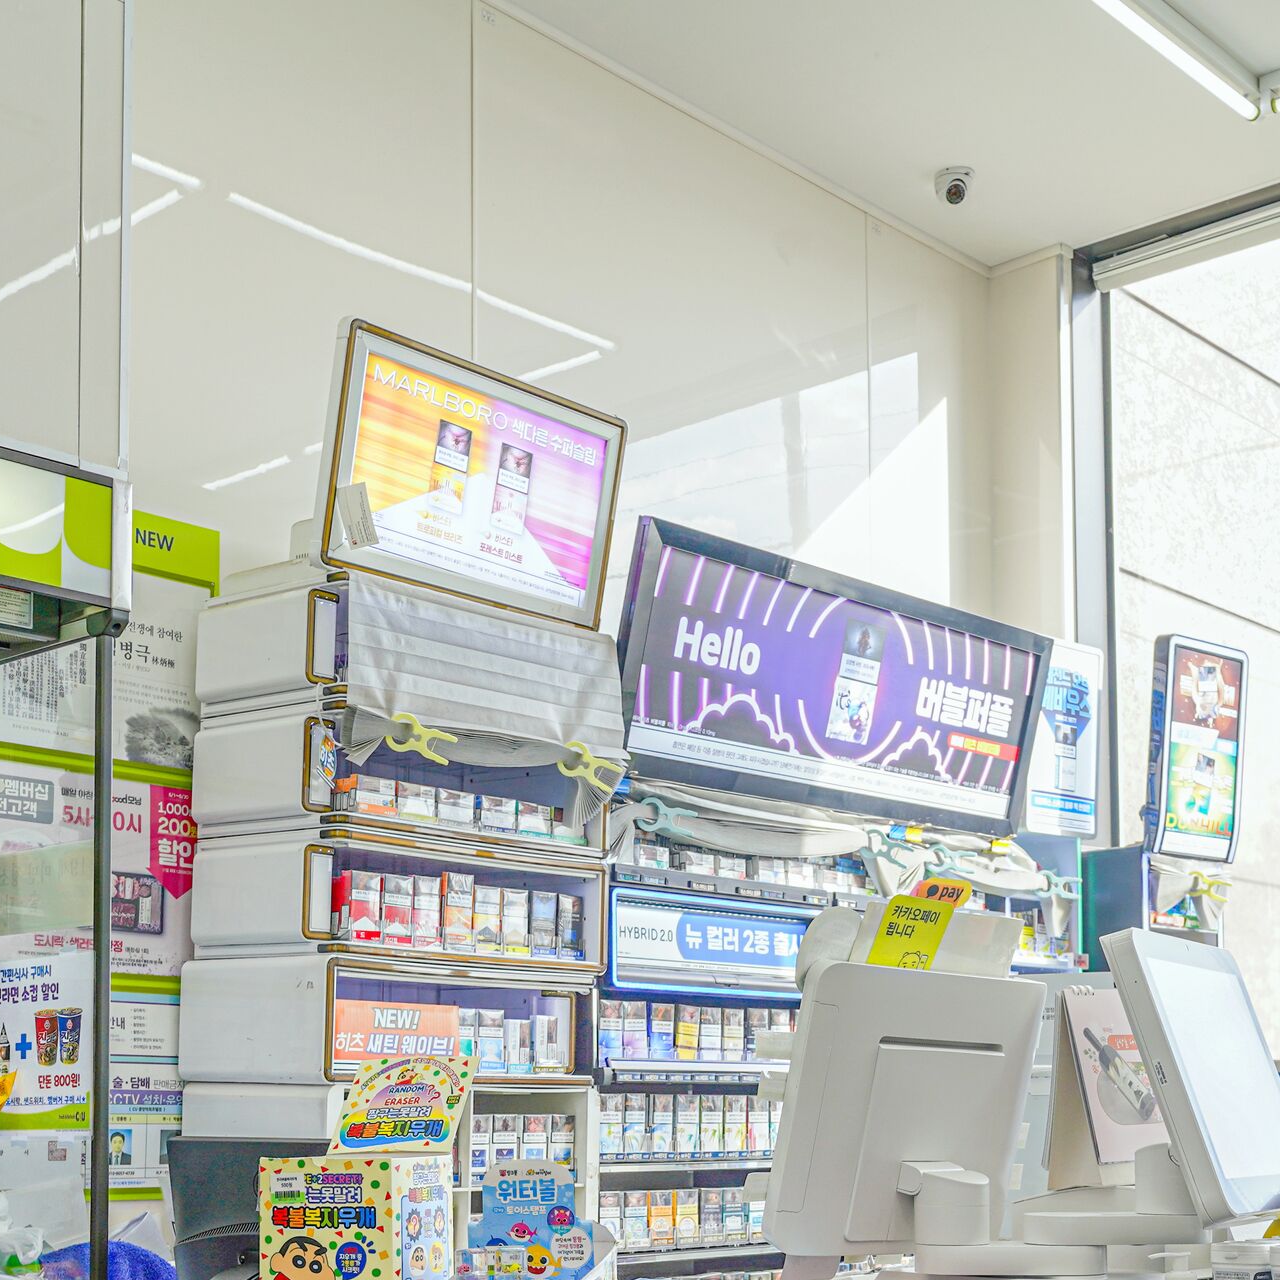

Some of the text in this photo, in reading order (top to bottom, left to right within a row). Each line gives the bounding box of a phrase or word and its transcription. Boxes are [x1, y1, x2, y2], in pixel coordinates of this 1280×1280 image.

[374, 364, 508, 430] MARLBORO
[550, 432, 597, 466] 수퍼슬림
[135, 527, 175, 552] NEW
[494, 532, 514, 547] 비스타
[479, 542, 504, 558] 포레스트
[156, 625, 184, 643] 참여한
[673, 615, 762, 676] Hello
[914, 675, 1015, 739] 버블퍼플
[938, 885, 965, 903] pay
[890, 904, 941, 926] 카카오페이
[618, 925, 675, 946] HYBRID 2.0
[884, 920, 915, 939] 됩니다
[685, 928, 770, 954] 뉴 컬러 2종
[0, 965, 52, 983] 간편식사 구매시
[21, 985, 39, 1002] 소컵
[41, 982, 60, 1001] 할인
[372, 1005, 422, 1030] NEW!
[335, 1032, 454, 1057] 히츠 새틴 웨이브!
[38, 1072, 80, 1090] 단돈 800원!
[388, 1085, 425, 1094] RANDOM
[384, 1096, 420, 1106] ERASER
[366, 1106, 432, 1120] 짱구는못말려
[346, 1120, 444, 1139] 복불복지우개
[497, 1175, 557, 1204] 워터볼
[271, 1205, 377, 1230] 복불복지우개
[505, 1205, 548, 1217] 토이스탬프
